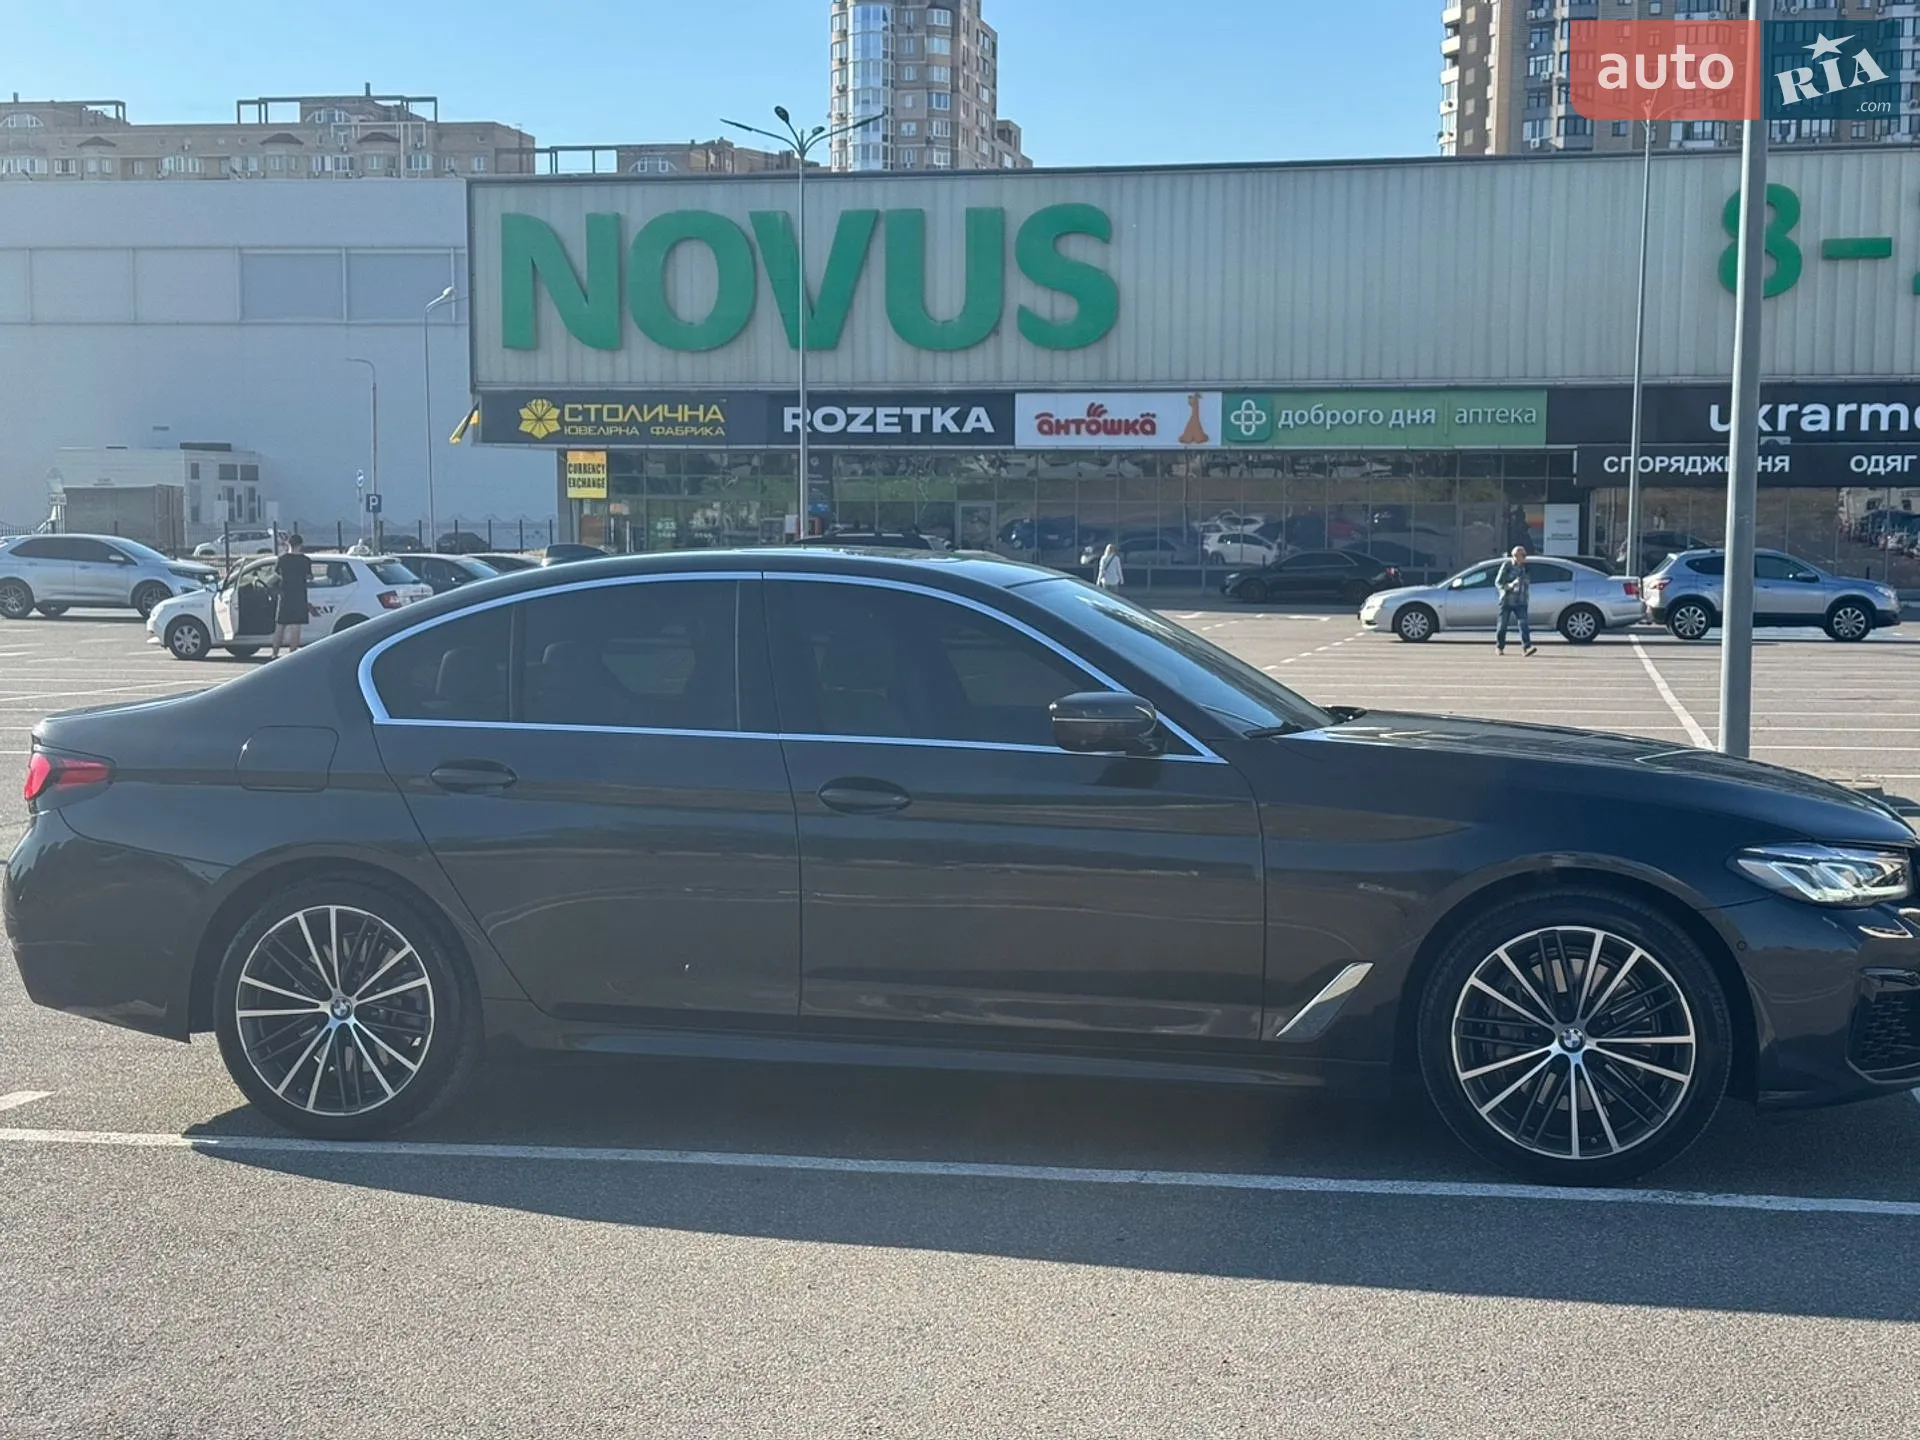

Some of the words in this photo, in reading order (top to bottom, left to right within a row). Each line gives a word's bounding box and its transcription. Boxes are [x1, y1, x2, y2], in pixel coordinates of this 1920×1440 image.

[1720, 183, 1920, 300] 8-
[501, 203, 1120, 352] NOVUS
[563, 404, 726, 424] СТОЛИЧНА
[783, 406, 995, 433] ROZETKA
[1278, 403, 1384, 429] доброго
[1389, 408, 1436, 428] дня
[1455, 406, 1537, 424] аптека
[1709, 402, 1920, 432] ukrarm
[563, 425, 641, 437] ЮВЕЛІРНА
[650, 426, 726, 437] ФАБРИКА
[568, 462, 606, 474] CURRENCY
[1849, 455, 1918, 476] ОДЯГ
[568, 477, 606, 489] EXCHANGE
[369, 495, 379, 511] P
